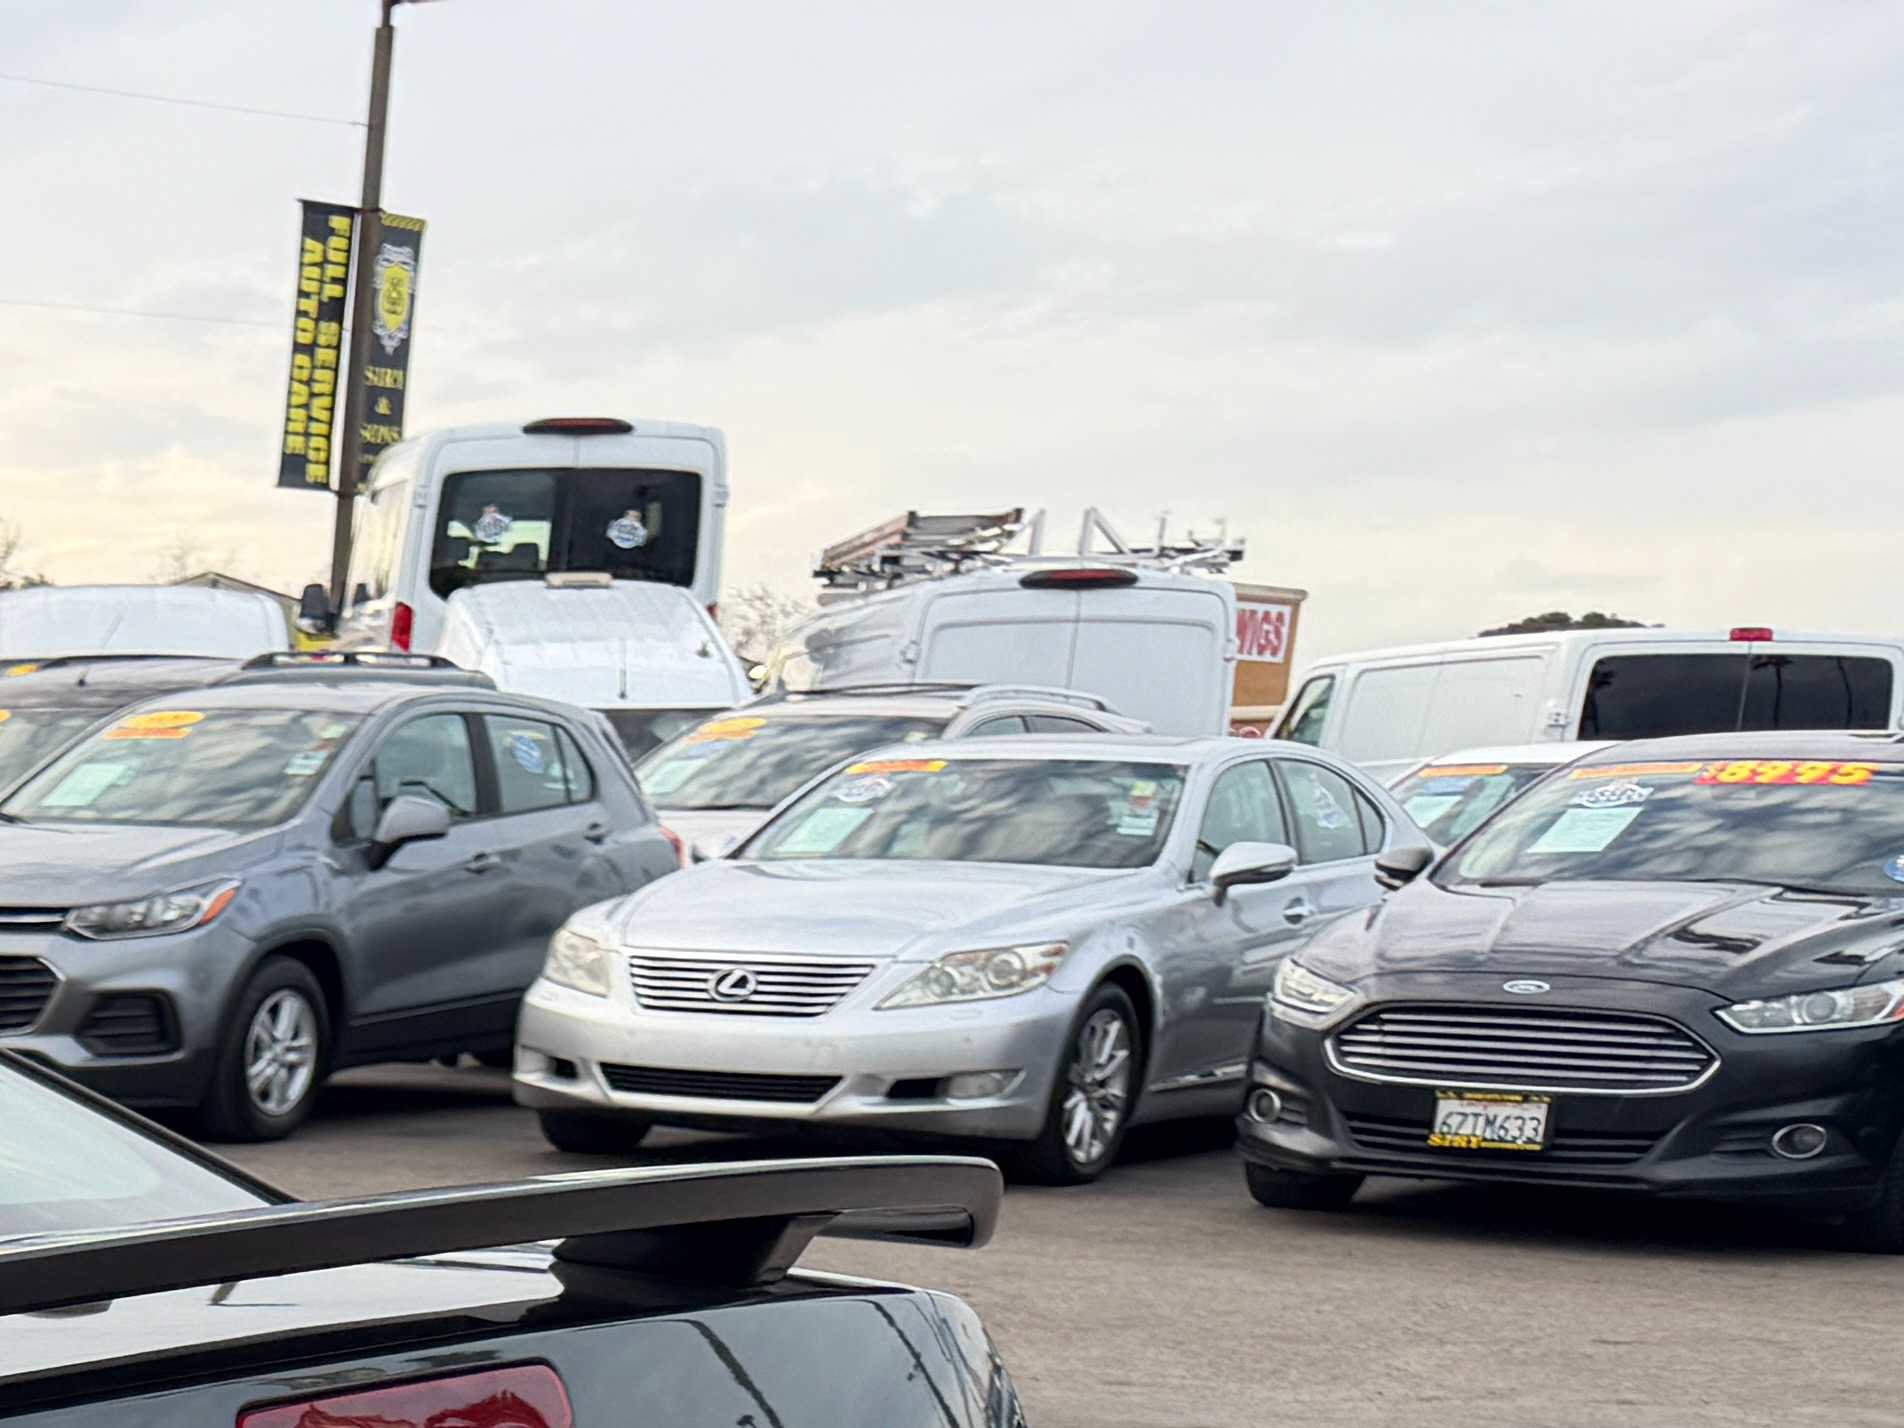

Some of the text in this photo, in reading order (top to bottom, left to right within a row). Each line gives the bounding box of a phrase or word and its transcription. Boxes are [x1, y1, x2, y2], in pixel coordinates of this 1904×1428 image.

[284, 237, 324, 455] AUTO CARE
[305, 215, 351, 483] FULL SERVICE
